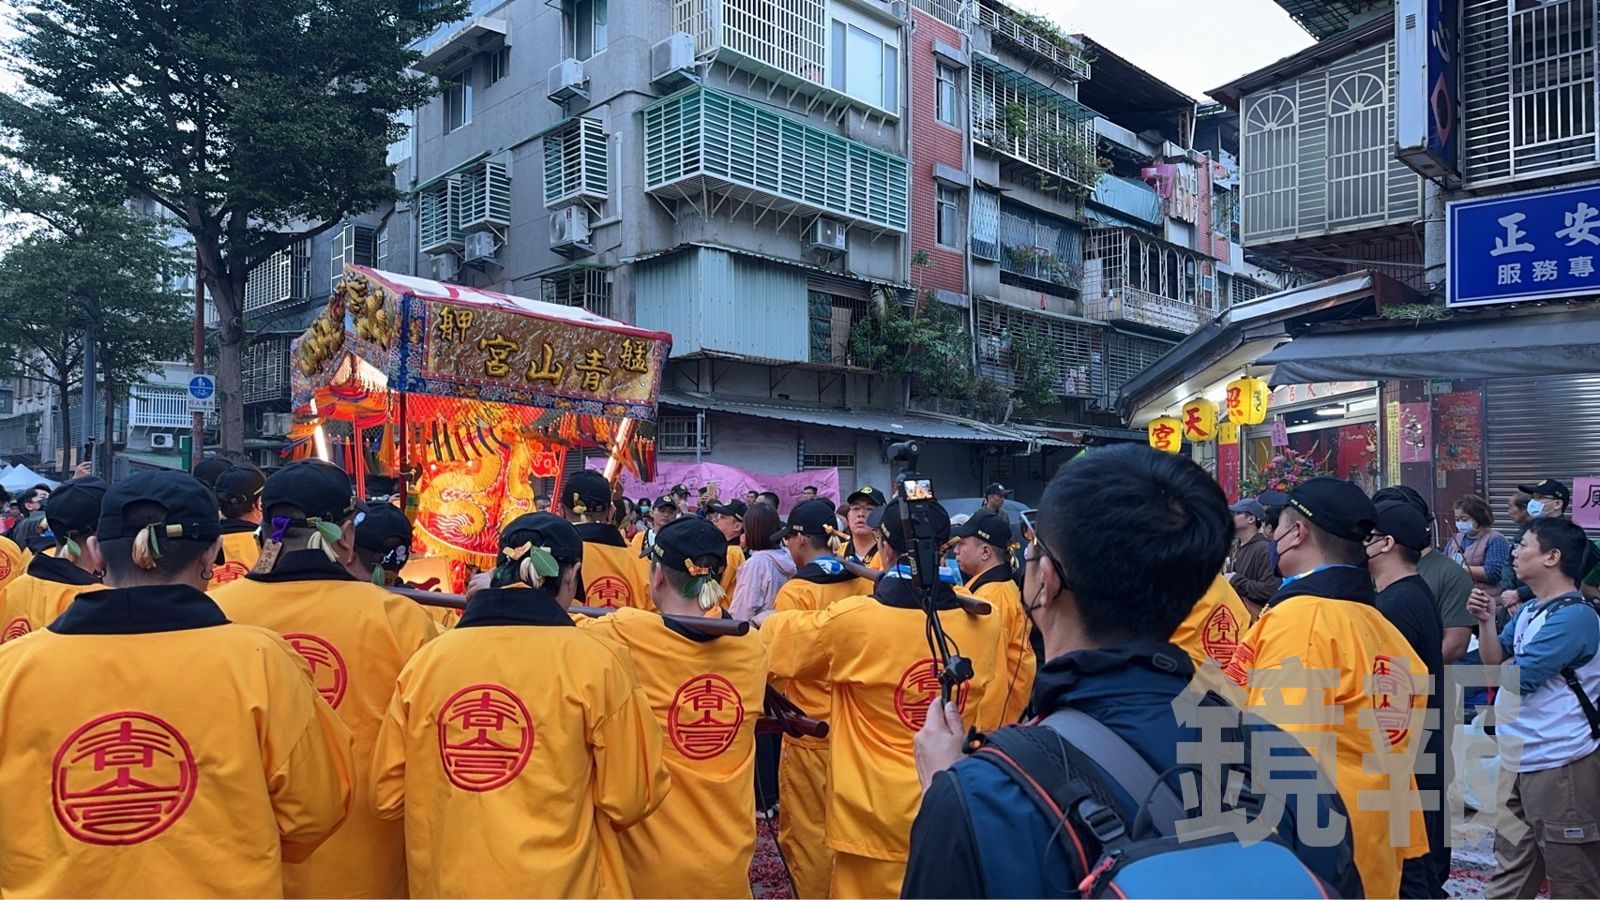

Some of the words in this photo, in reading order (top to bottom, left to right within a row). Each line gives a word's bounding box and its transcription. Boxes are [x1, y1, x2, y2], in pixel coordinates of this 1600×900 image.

[1497, 255, 1595, 286] 服務專
[1151, 423, 1174, 449] 宮
[1184, 406, 1208, 437] 天
